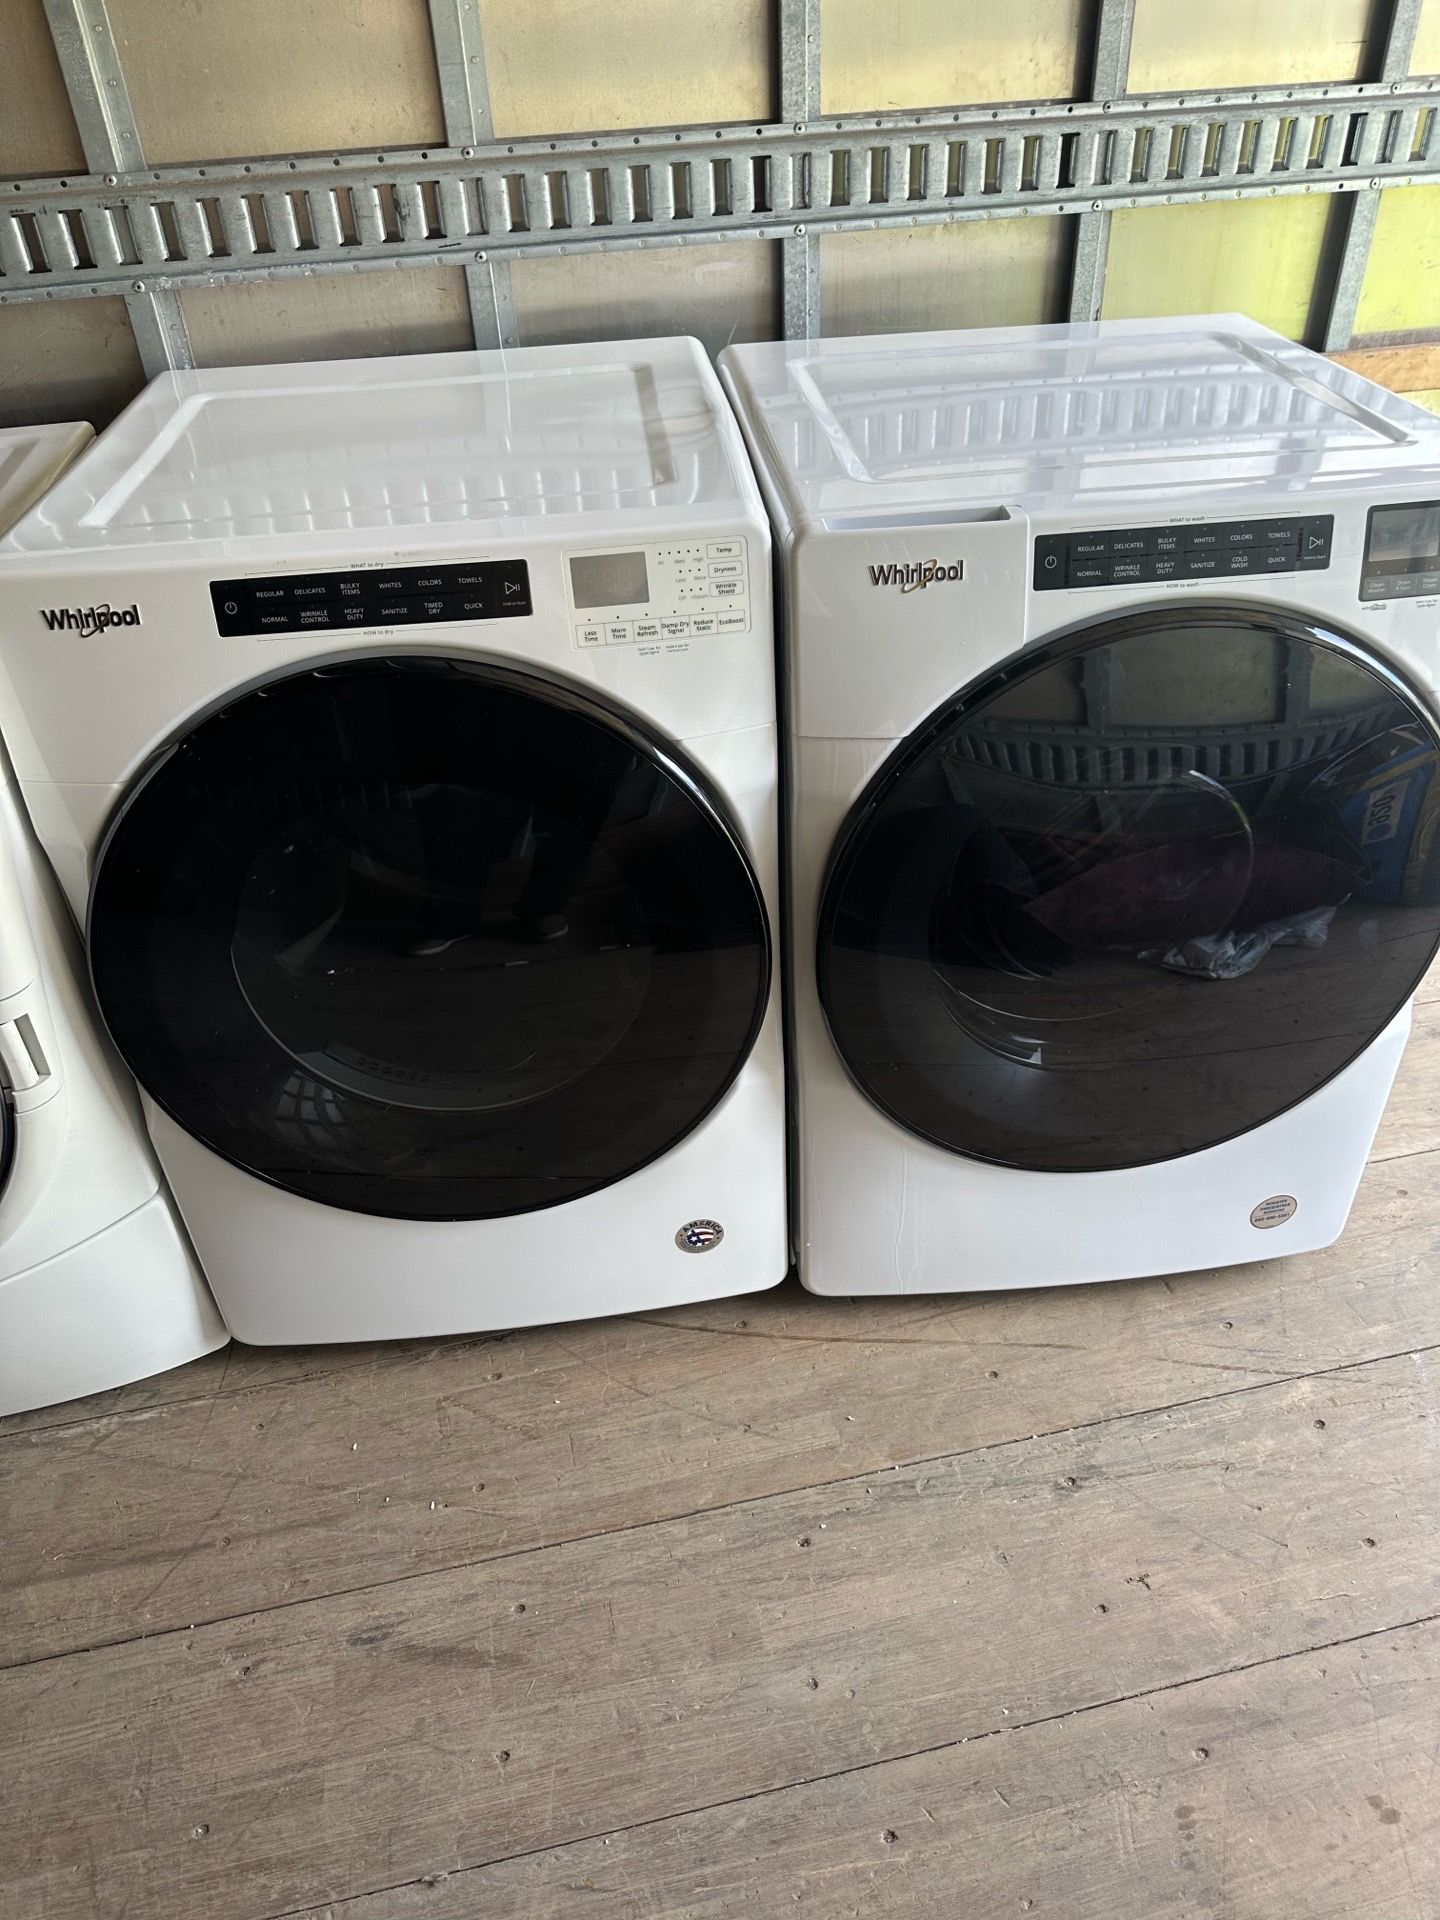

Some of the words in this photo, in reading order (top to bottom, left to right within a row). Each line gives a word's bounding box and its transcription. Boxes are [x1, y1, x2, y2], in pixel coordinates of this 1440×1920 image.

[1114, 541, 1144, 550] DELICATES
[1268, 556, 1286, 564] QUICK
[458, 576, 482, 584] TOWELS
[870, 560, 966, 592] Whirlpool
[418, 579, 442, 587] COLORS
[294, 587, 326, 595] DELICATES
[464, 602, 483, 610] QUICK
[381, 607, 408, 615] SANITIZE
[41, 604, 141, 638] Whirlpool
[262, 616, 288, 624] NORMAL
[300, 616, 330, 624] CONTROL
[719, 617, 744, 625] EcoBoost
[683, 1220, 722, 1234] AMERICA
